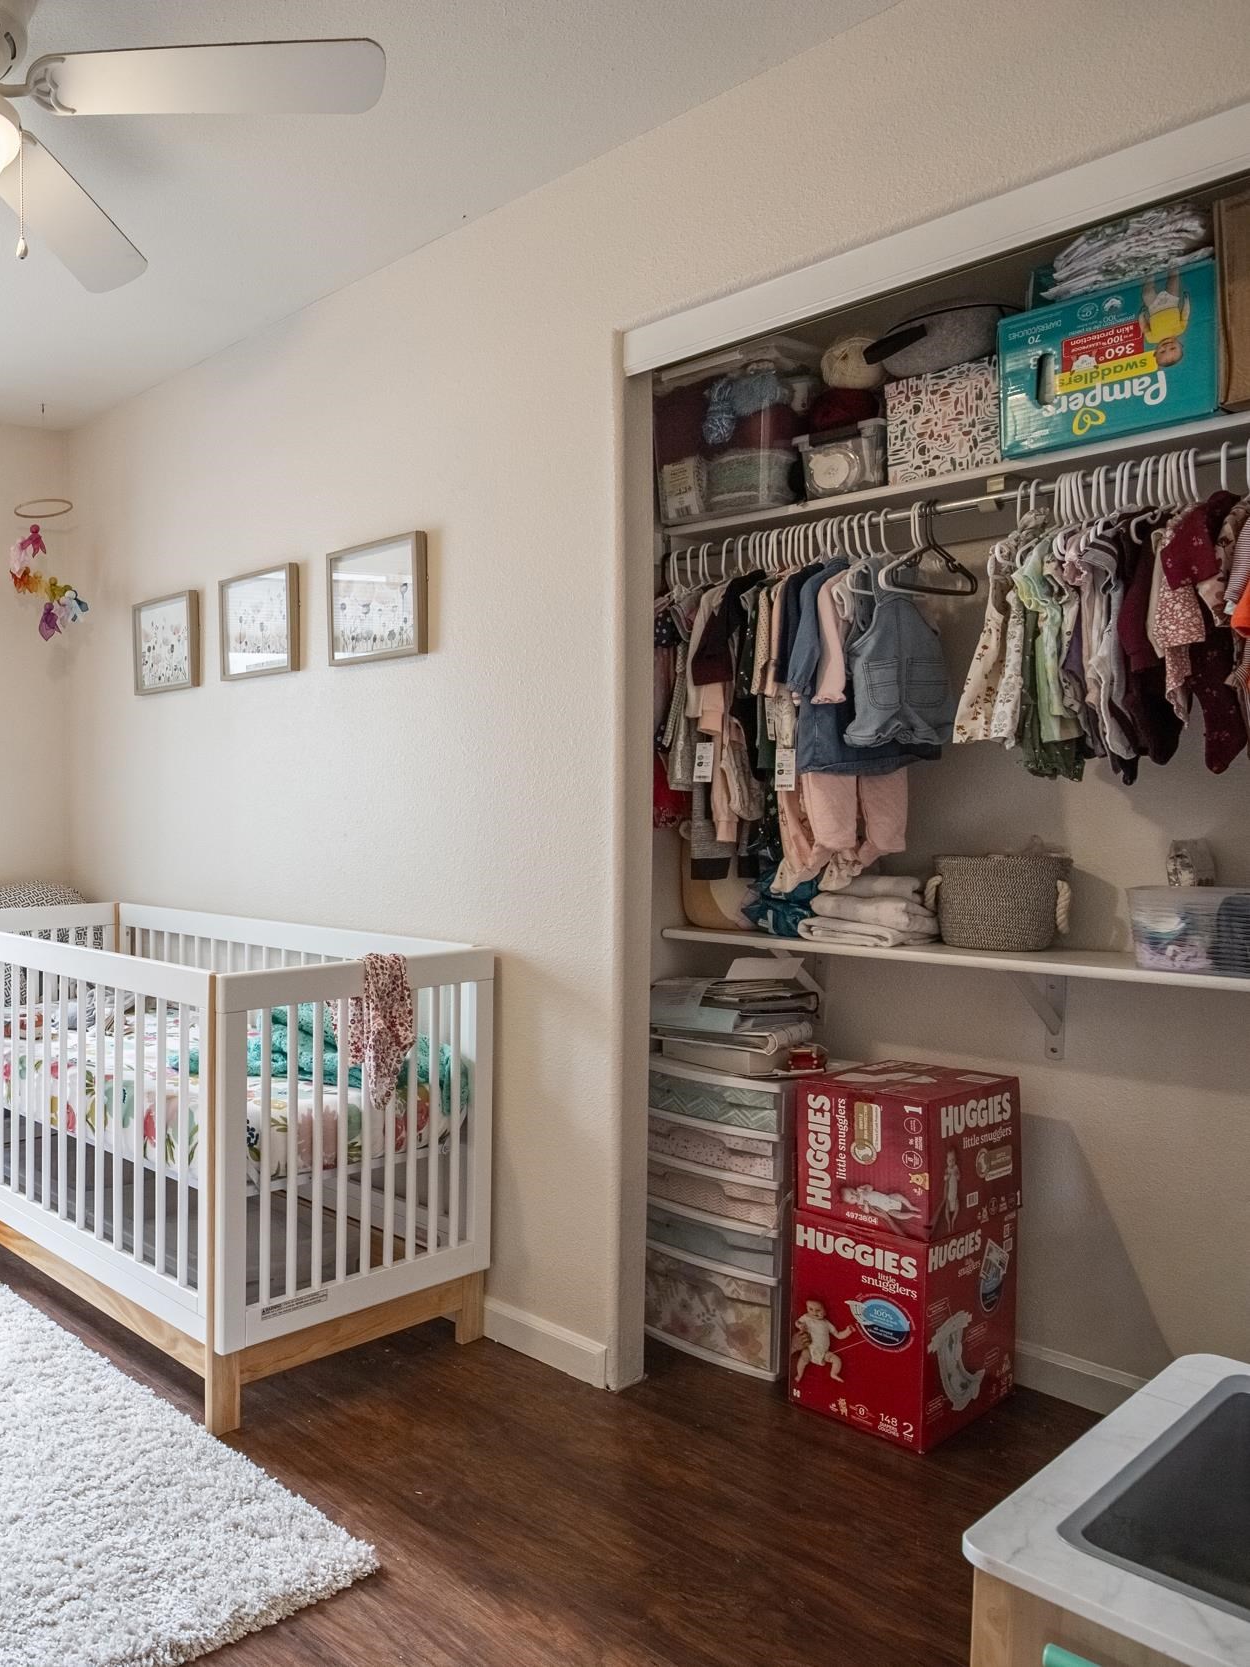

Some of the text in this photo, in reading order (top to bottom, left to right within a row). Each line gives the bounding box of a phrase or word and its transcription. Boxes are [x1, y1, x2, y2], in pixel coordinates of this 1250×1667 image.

[1028, 334, 1042, 345] 70
[1070, 325, 1134, 346] skin protection
[1099, 342, 1135, 362] 360°
[1058, 357, 1147, 387] swaddlers
[1041, 371, 1168, 418] Pampers
[904, 1105, 923, 1115] 1
[940, 1092, 1012, 1139] HUGGIES
[835, 1097, 849, 1180] little snugglers
[962, 1126, 1012, 1149] little snugglers
[806, 1093, 832, 1210] HUGGIES
[795, 1223, 918, 1279] HUGGIES
[928, 1228, 982, 1273] HUGGIES
[861, 1274, 918, 1300] snugglers
[877, 1272, 897, 1284] little
[879, 1413, 898, 1427] 148
[902, 1422, 914, 1437] 2
